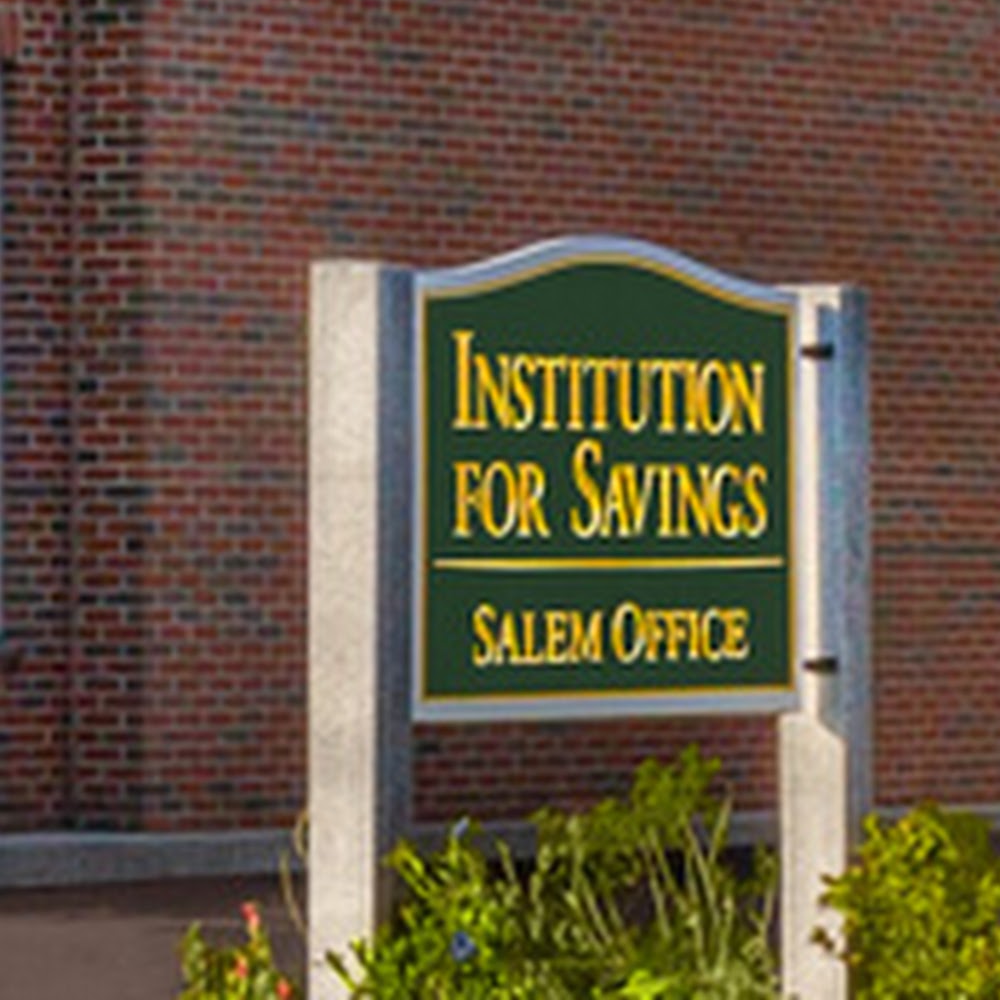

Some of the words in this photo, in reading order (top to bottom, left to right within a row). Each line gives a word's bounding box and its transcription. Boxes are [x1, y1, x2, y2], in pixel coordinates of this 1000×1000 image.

[452, 330, 765, 434] INSTITUTION
[453, 461, 550, 538] FOR
[570, 439, 767, 538] SAVINGS
[472, 602, 602, 667] SALEM
[611, 602, 749, 663] OFFICE
